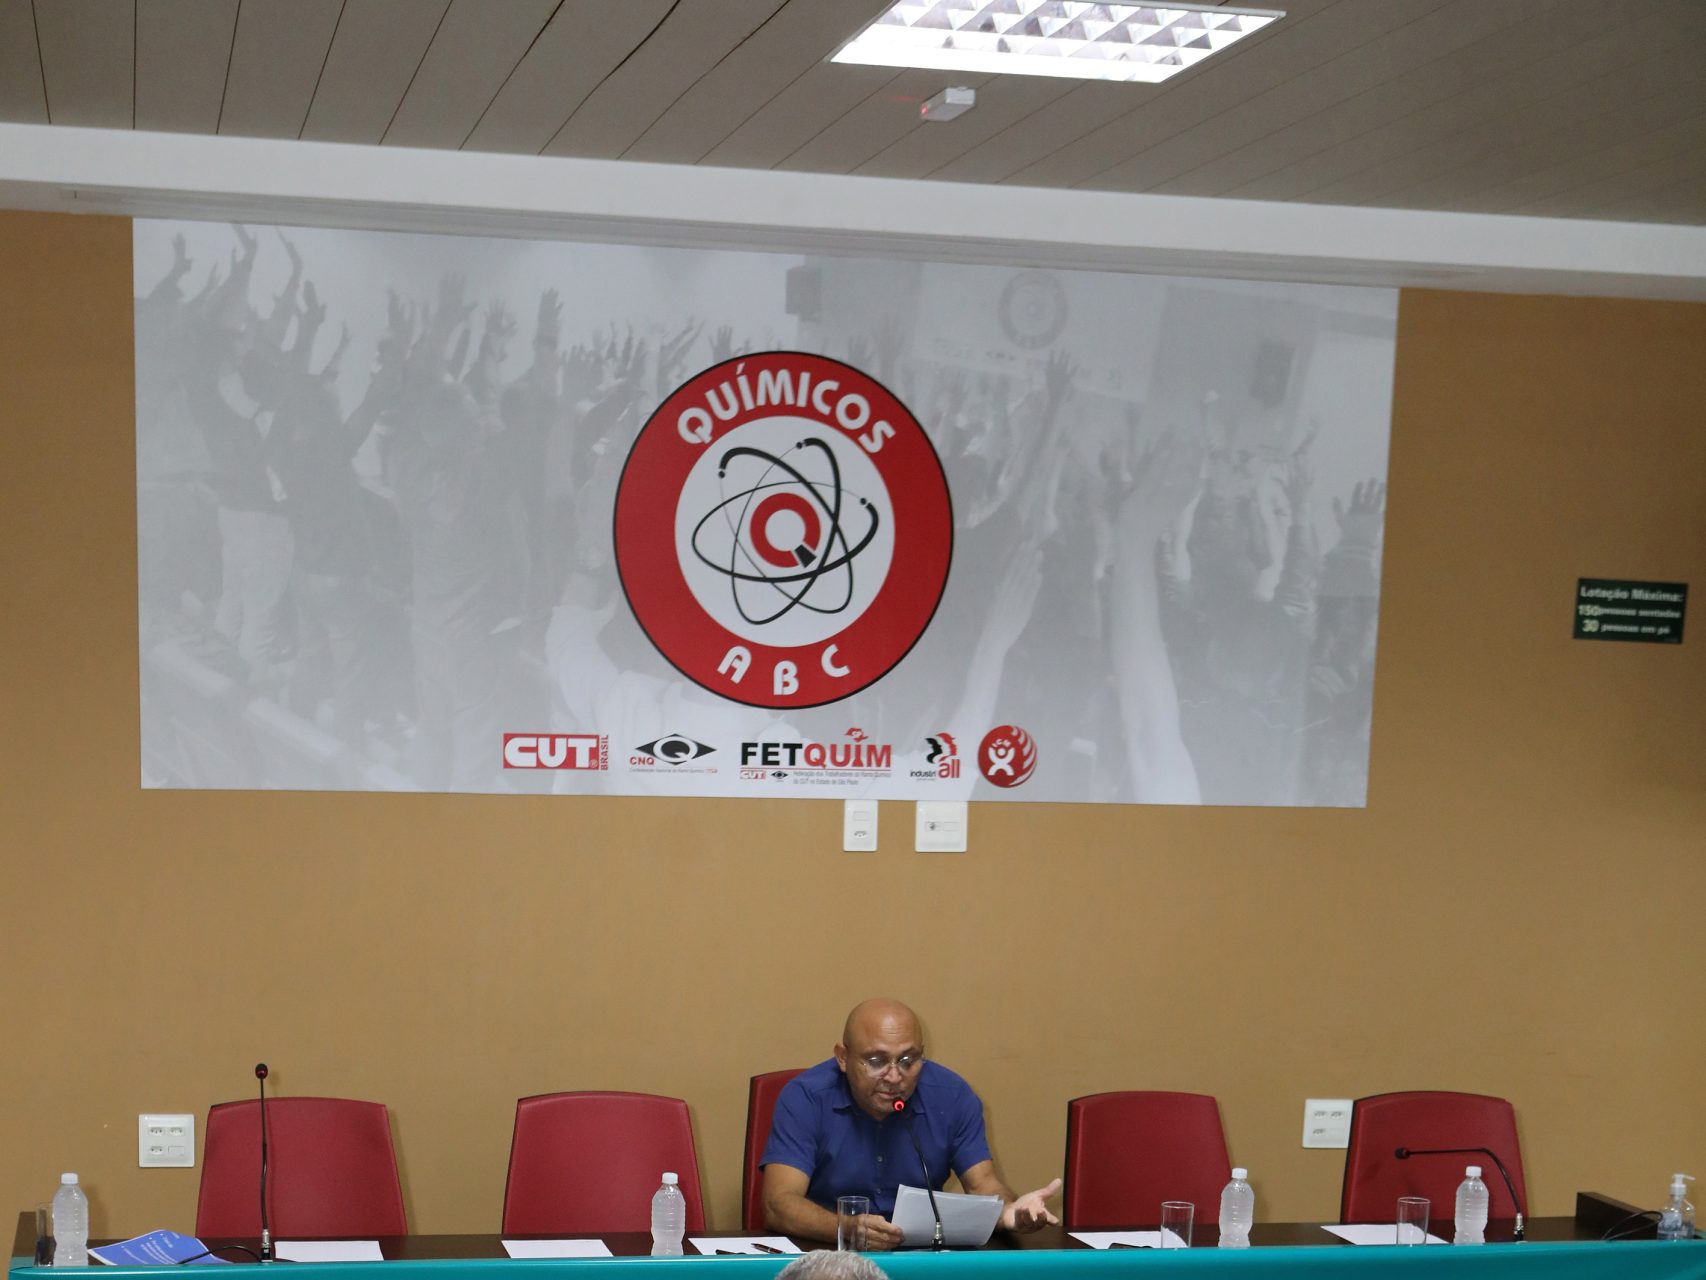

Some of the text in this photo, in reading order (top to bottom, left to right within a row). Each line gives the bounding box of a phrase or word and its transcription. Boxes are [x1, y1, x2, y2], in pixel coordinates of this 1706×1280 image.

[677, 362, 897, 456] QUÍMICOS
[504, 736, 597, 768] CUT
[601, 734, 609, 771] BRASIL
[629, 756, 655, 766] CNQ
[740, 770, 764, 780] CUT
